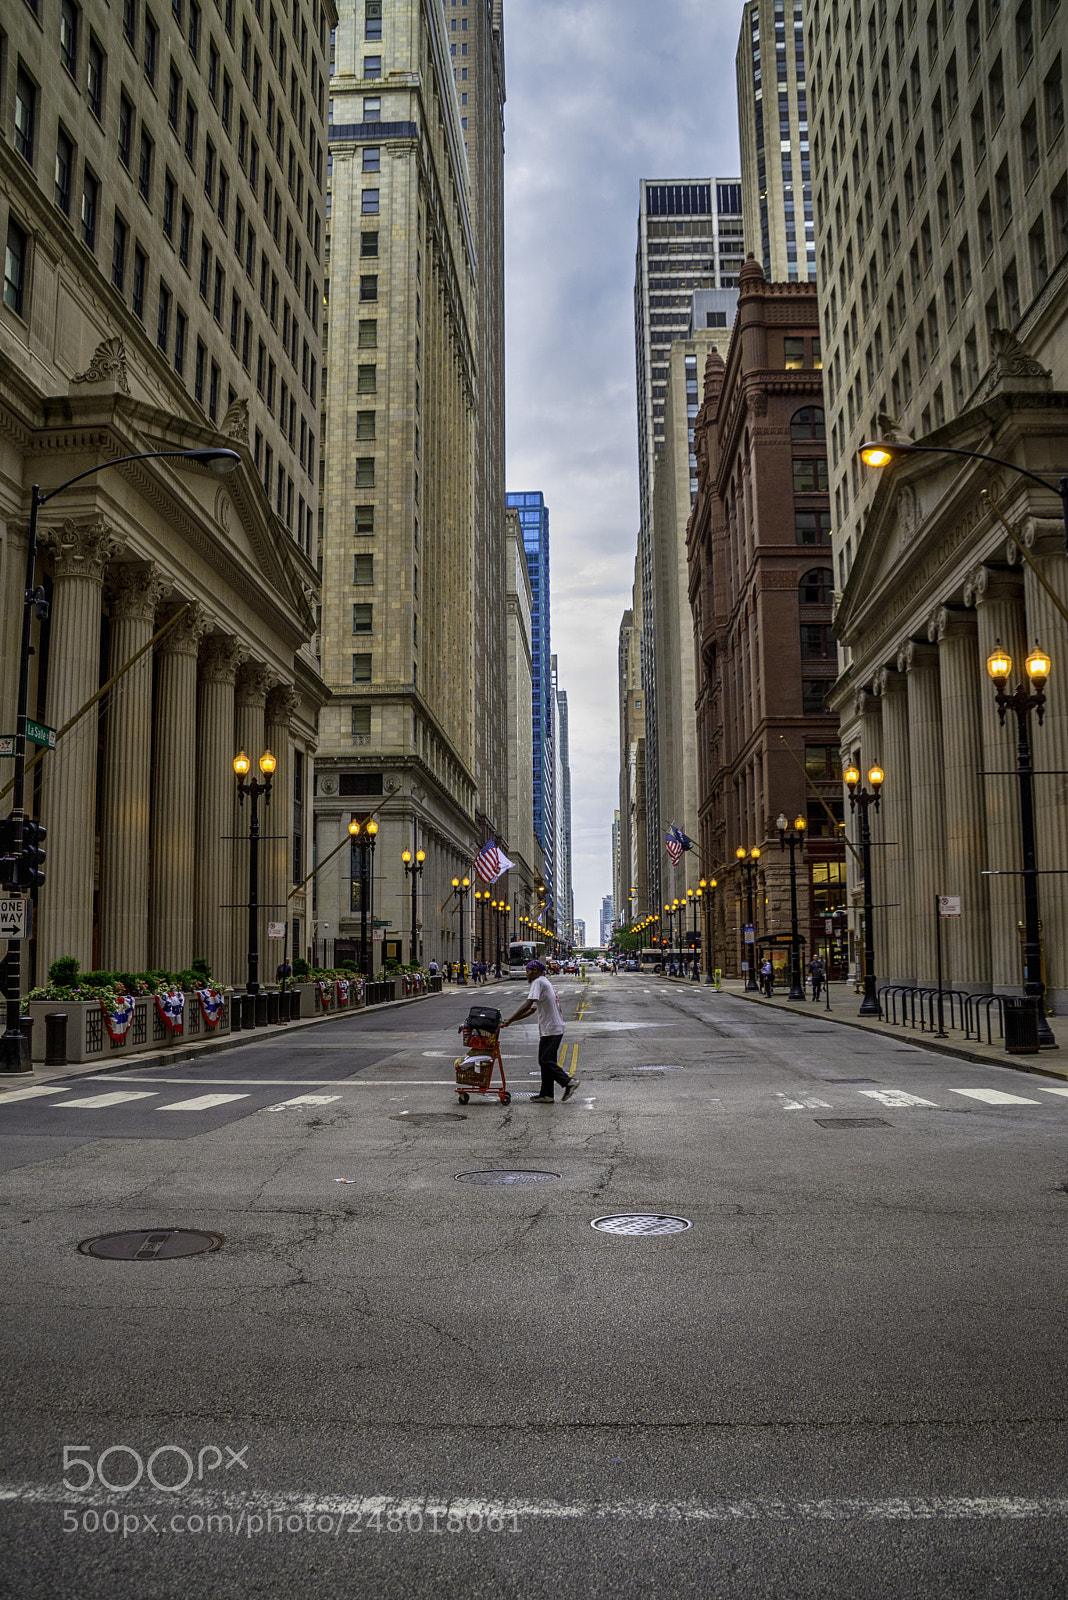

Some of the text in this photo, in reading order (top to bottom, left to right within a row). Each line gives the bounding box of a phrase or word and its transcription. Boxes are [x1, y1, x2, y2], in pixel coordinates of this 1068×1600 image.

[938, 468, 1007, 564] CORPORATON
[1, 901, 23, 912] ONE
[0, 912, 23, 923] WAY
